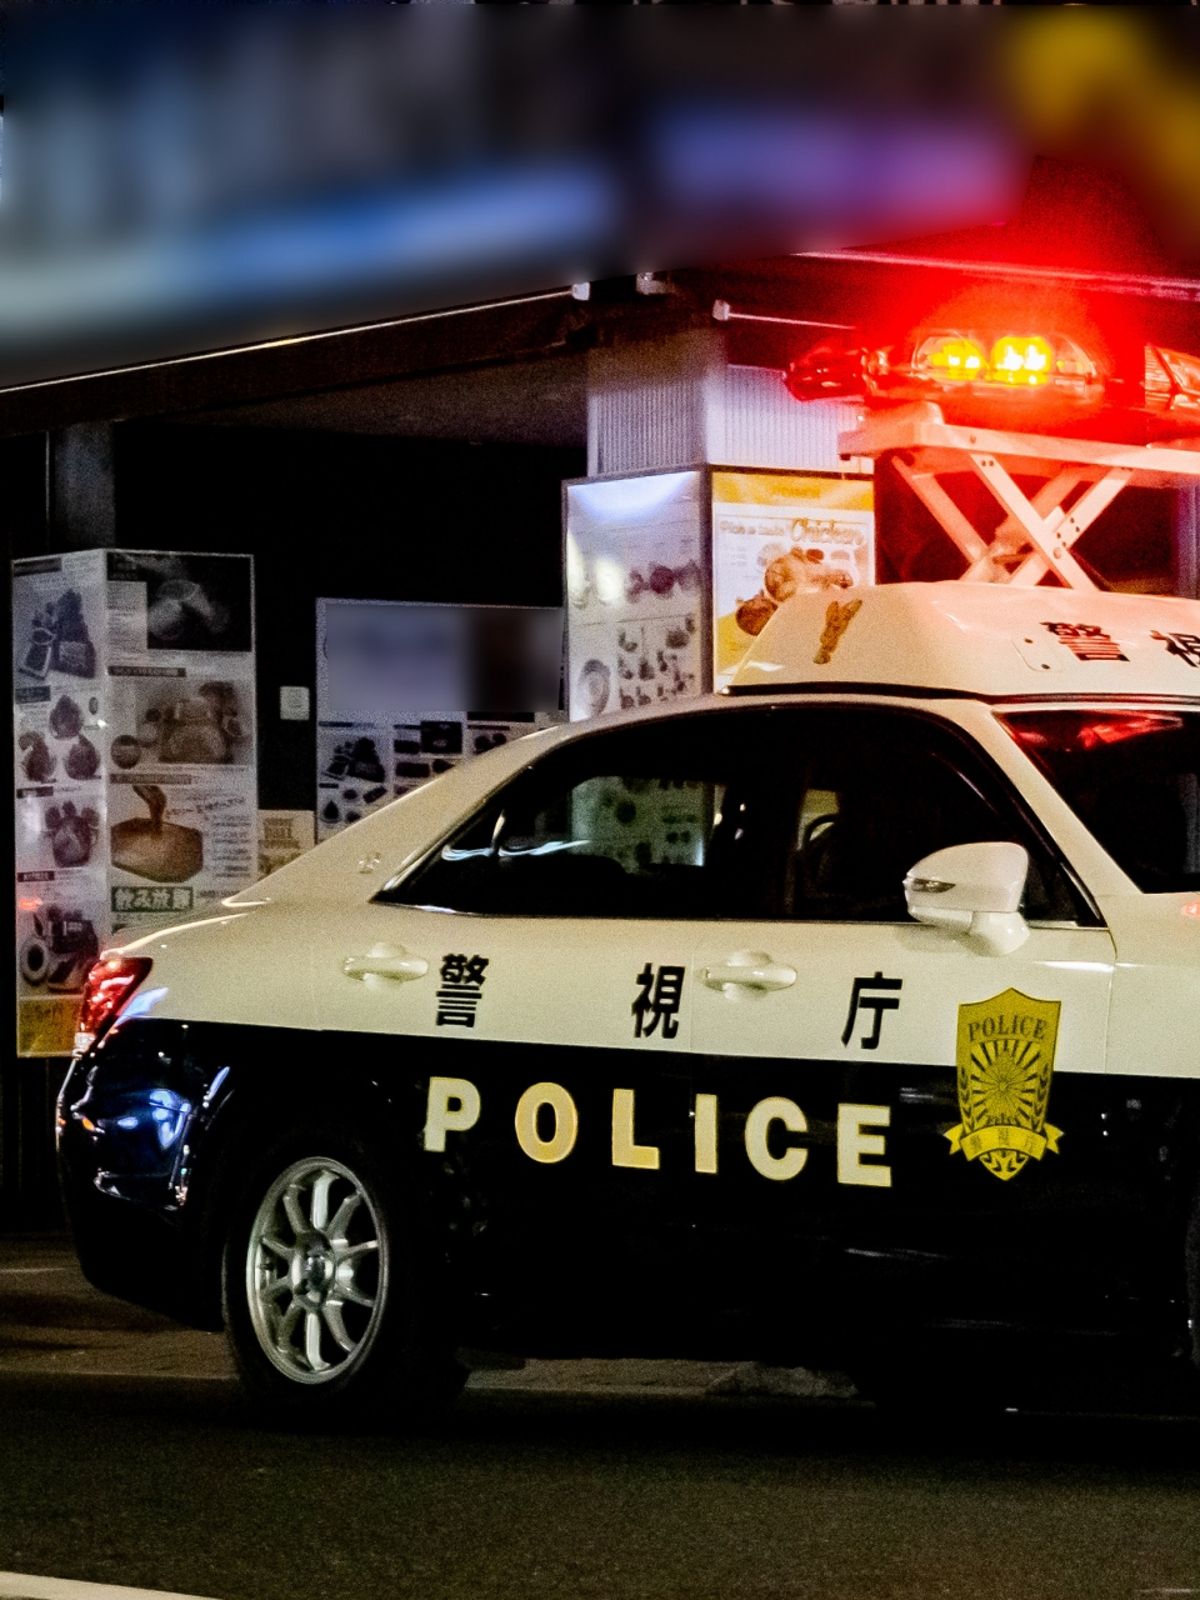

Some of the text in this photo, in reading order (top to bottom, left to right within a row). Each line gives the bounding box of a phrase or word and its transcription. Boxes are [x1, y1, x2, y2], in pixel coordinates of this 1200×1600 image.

[435, 953, 903, 1050] 警視庁
[967, 1014, 1050, 1042] POLICE
[423, 1075, 893, 1188] POLICE
